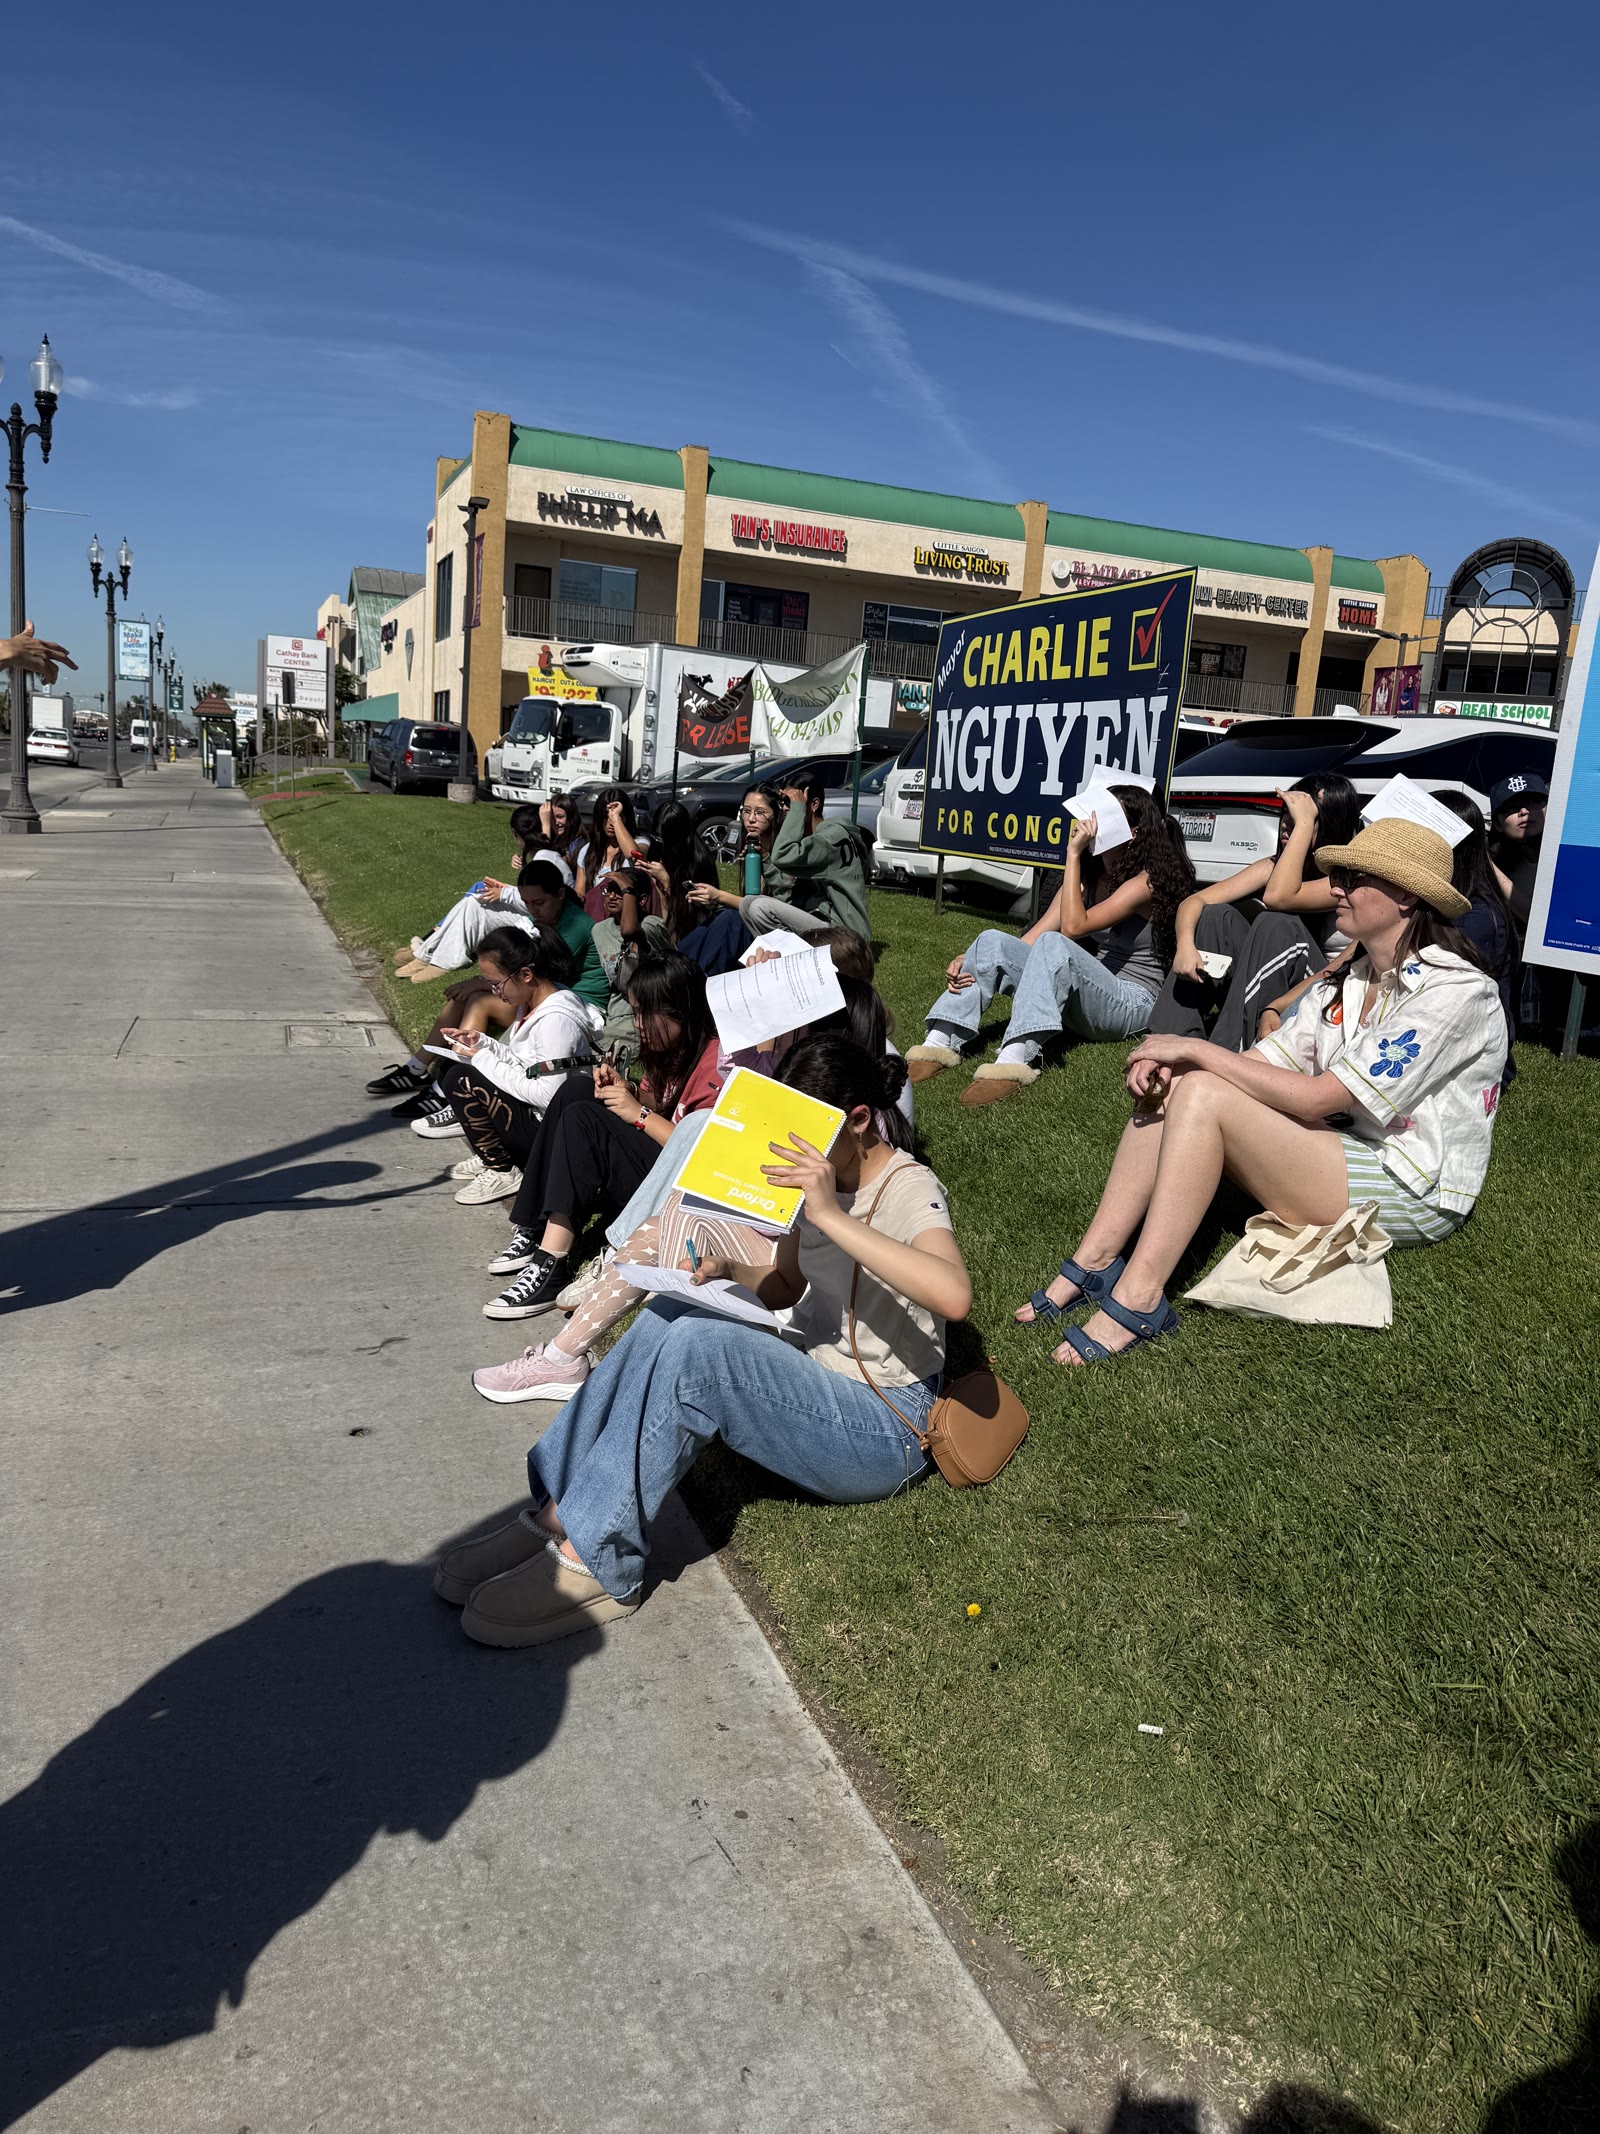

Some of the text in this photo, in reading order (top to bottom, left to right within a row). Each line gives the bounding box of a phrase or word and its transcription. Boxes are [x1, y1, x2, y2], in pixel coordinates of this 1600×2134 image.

[570, 486, 628, 501] LAW OFFICES OF
[537, 490, 663, 530] PHILLIP MA
[732, 514, 846, 552] TAN'S INSURANCE
[937, 541, 986, 554] LITTLE SAIGON
[914, 546, 1009, 577] LIVING TRUST
[1217, 588, 1263, 607] BEAUTY
[1266, 595, 1309, 614] CENTER
[1343, 599, 1358, 607] LITTLE
[1340, 607, 1377, 626] HOME
[276, 649, 319, 660] Cathay Bank
[283, 658, 311, 667] CENTER
[937, 630, 966, 693] Mayor
[963, 616, 1112, 688] CHARLIE
[1462, 703, 1550, 721] BEAR SCHOOL
[931, 695, 1169, 797] NGUYEN
[937, 807, 1079, 845] FOR CONG
[726, 1186, 776, 1212] Oxford
